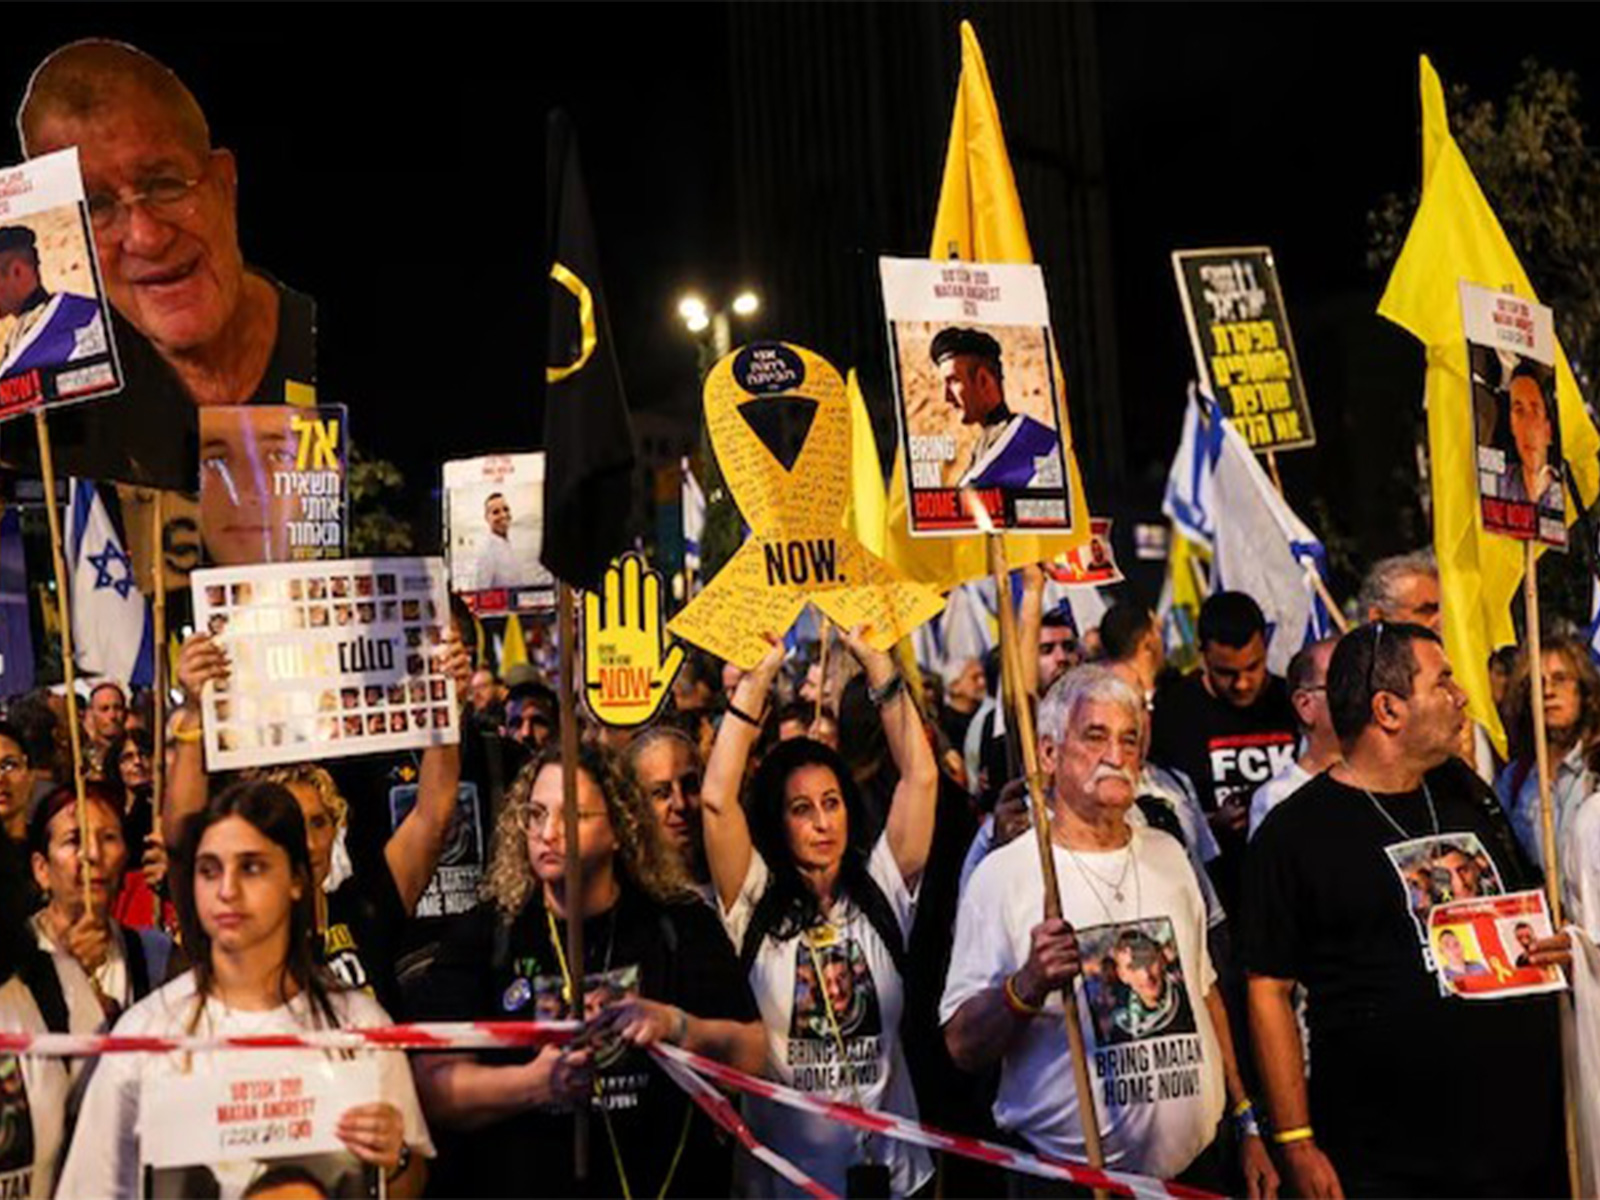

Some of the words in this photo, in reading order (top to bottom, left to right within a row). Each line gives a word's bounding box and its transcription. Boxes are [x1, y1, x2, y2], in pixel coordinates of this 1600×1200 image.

[289, 415, 340, 471] אל
[301, 496, 340, 520] אותי
[286, 521, 340, 546] מאחור
[763, 539, 846, 587] NOW.
[598, 667, 651, 699] NOW
[1210, 744, 1295, 782] FCK
[788, 1038, 833, 1066] BRING
[1095, 1045, 1150, 1078] BRING
[793, 1064, 836, 1092] HOME
[1103, 1076, 1155, 1107] HOME
[1157, 1068, 1200, 1101] NOW!
